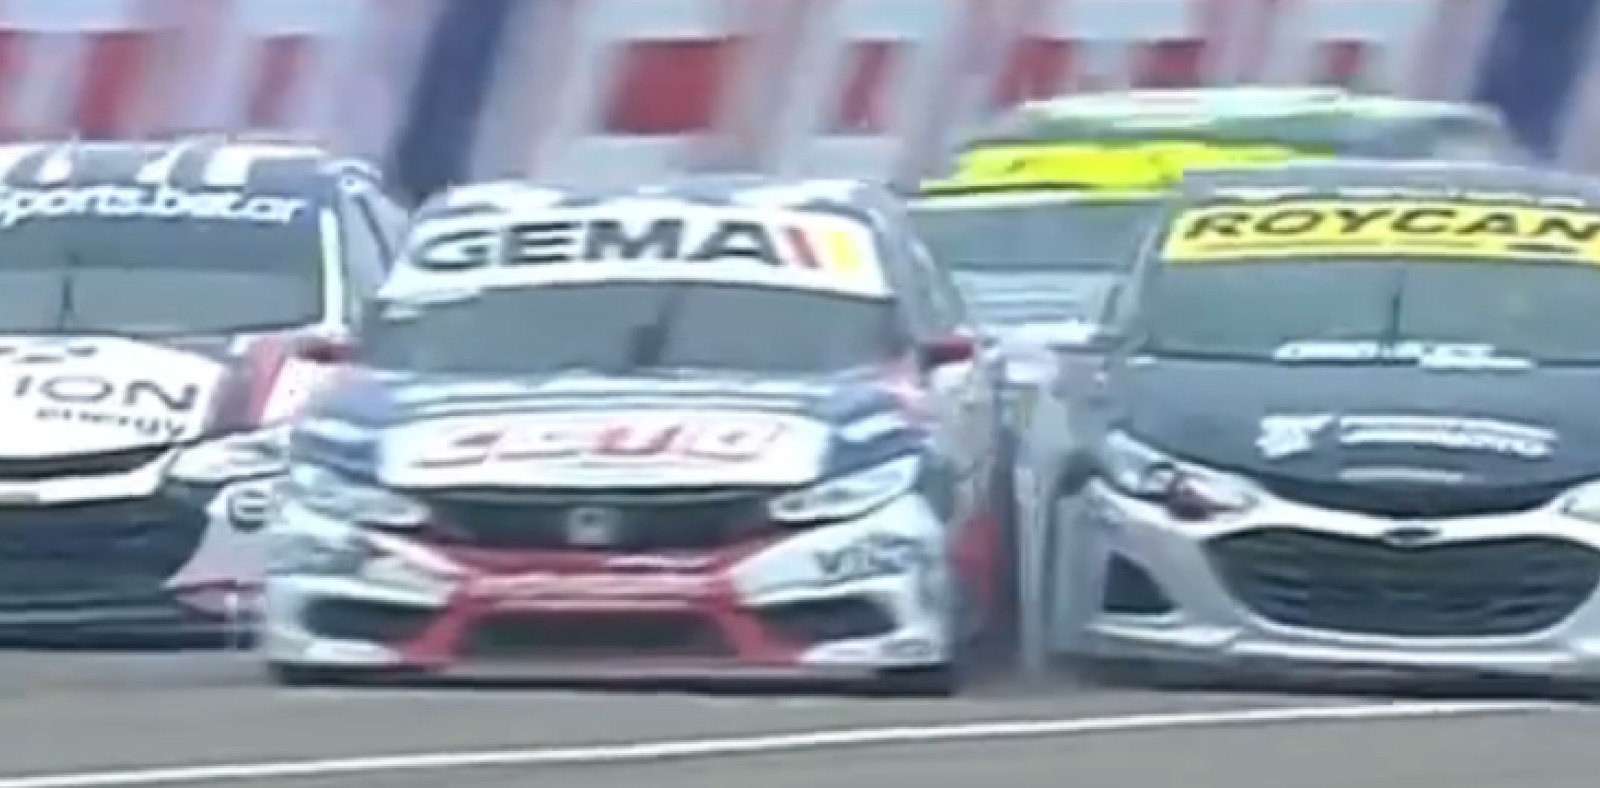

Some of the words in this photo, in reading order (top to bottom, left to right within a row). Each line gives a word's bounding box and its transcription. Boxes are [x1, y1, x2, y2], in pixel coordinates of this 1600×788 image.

[410, 217, 784, 272] GEMA
[1183, 208, 1600, 243] ROYCAN
[35, 407, 187, 445] energy
